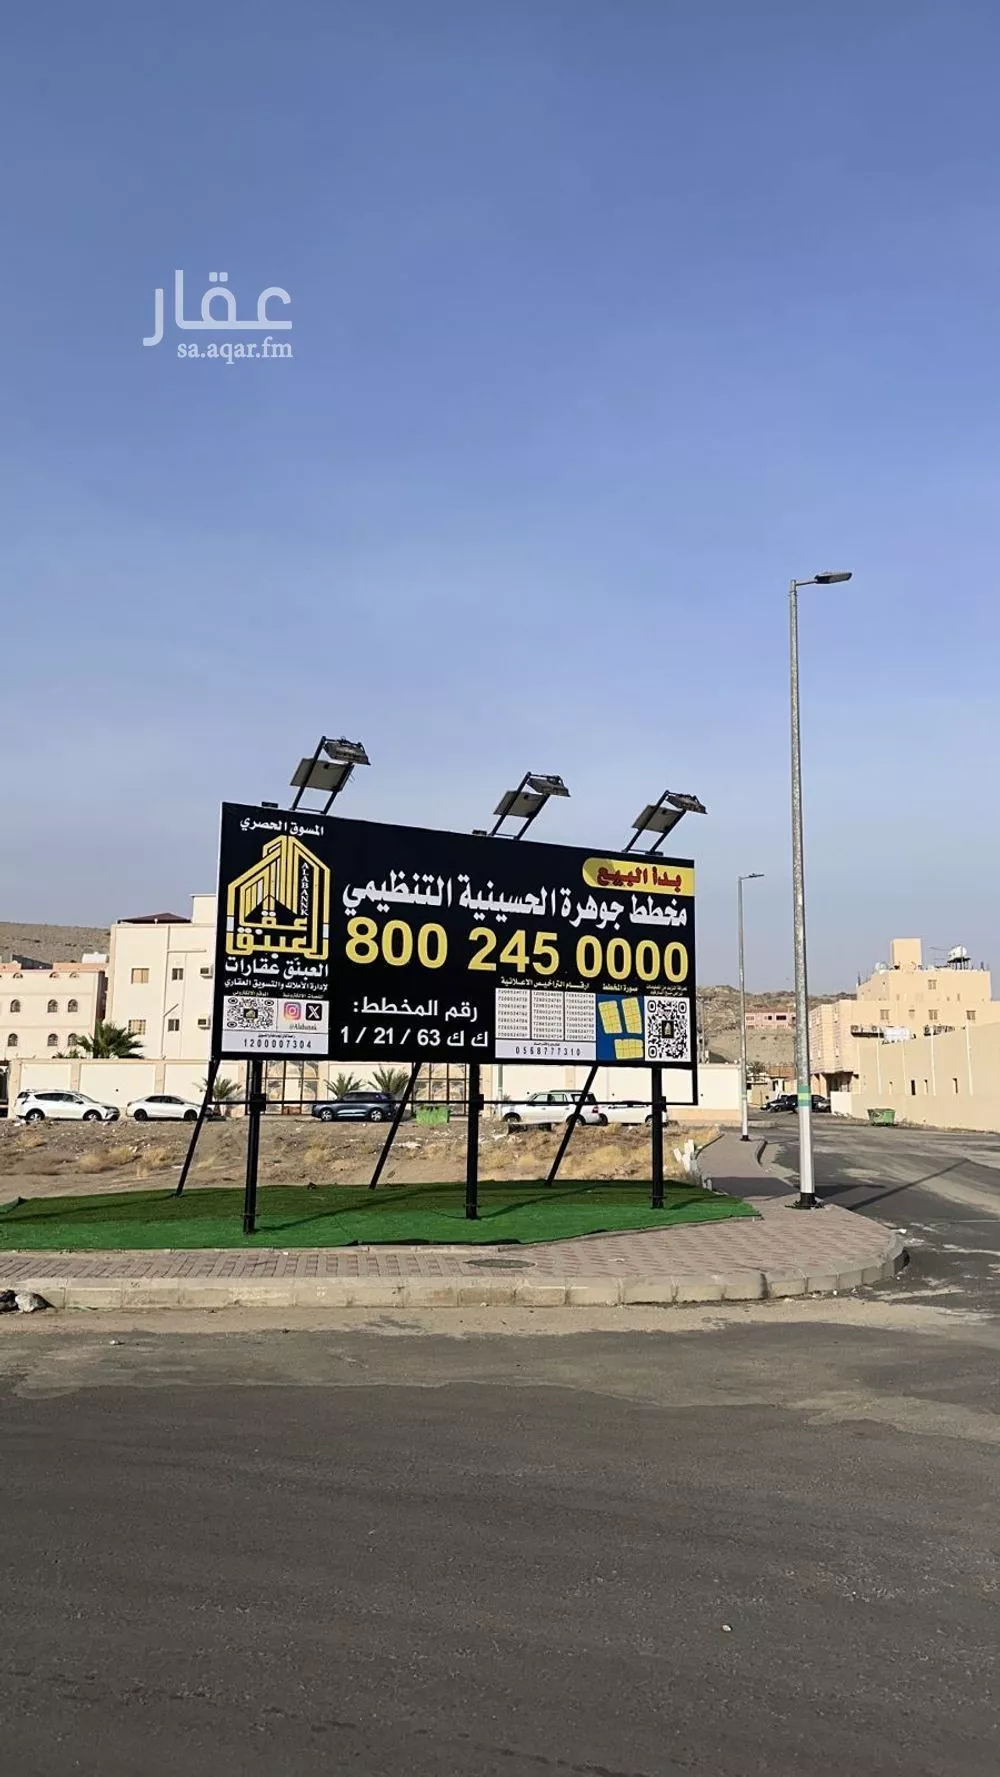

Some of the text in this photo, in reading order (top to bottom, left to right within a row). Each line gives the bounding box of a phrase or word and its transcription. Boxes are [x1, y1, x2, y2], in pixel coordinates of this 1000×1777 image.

[240, 817, 324, 836] المسوق الحصري
[597, 866, 682, 893] بدأ البيع
[342, 869, 688, 930] مخطط جوهرة الحسينية التنظيمي
[345, 916, 689, 983] 800 245 0000
[225, 956, 280, 976] عقارات
[224, 978, 252, 988] العقاري
[353, 996, 438, 1017] المخطط:
[445, 1001, 478, 1022] رقم
[340, 1025, 488, 1047] ك ك 63 / 21 / 1
